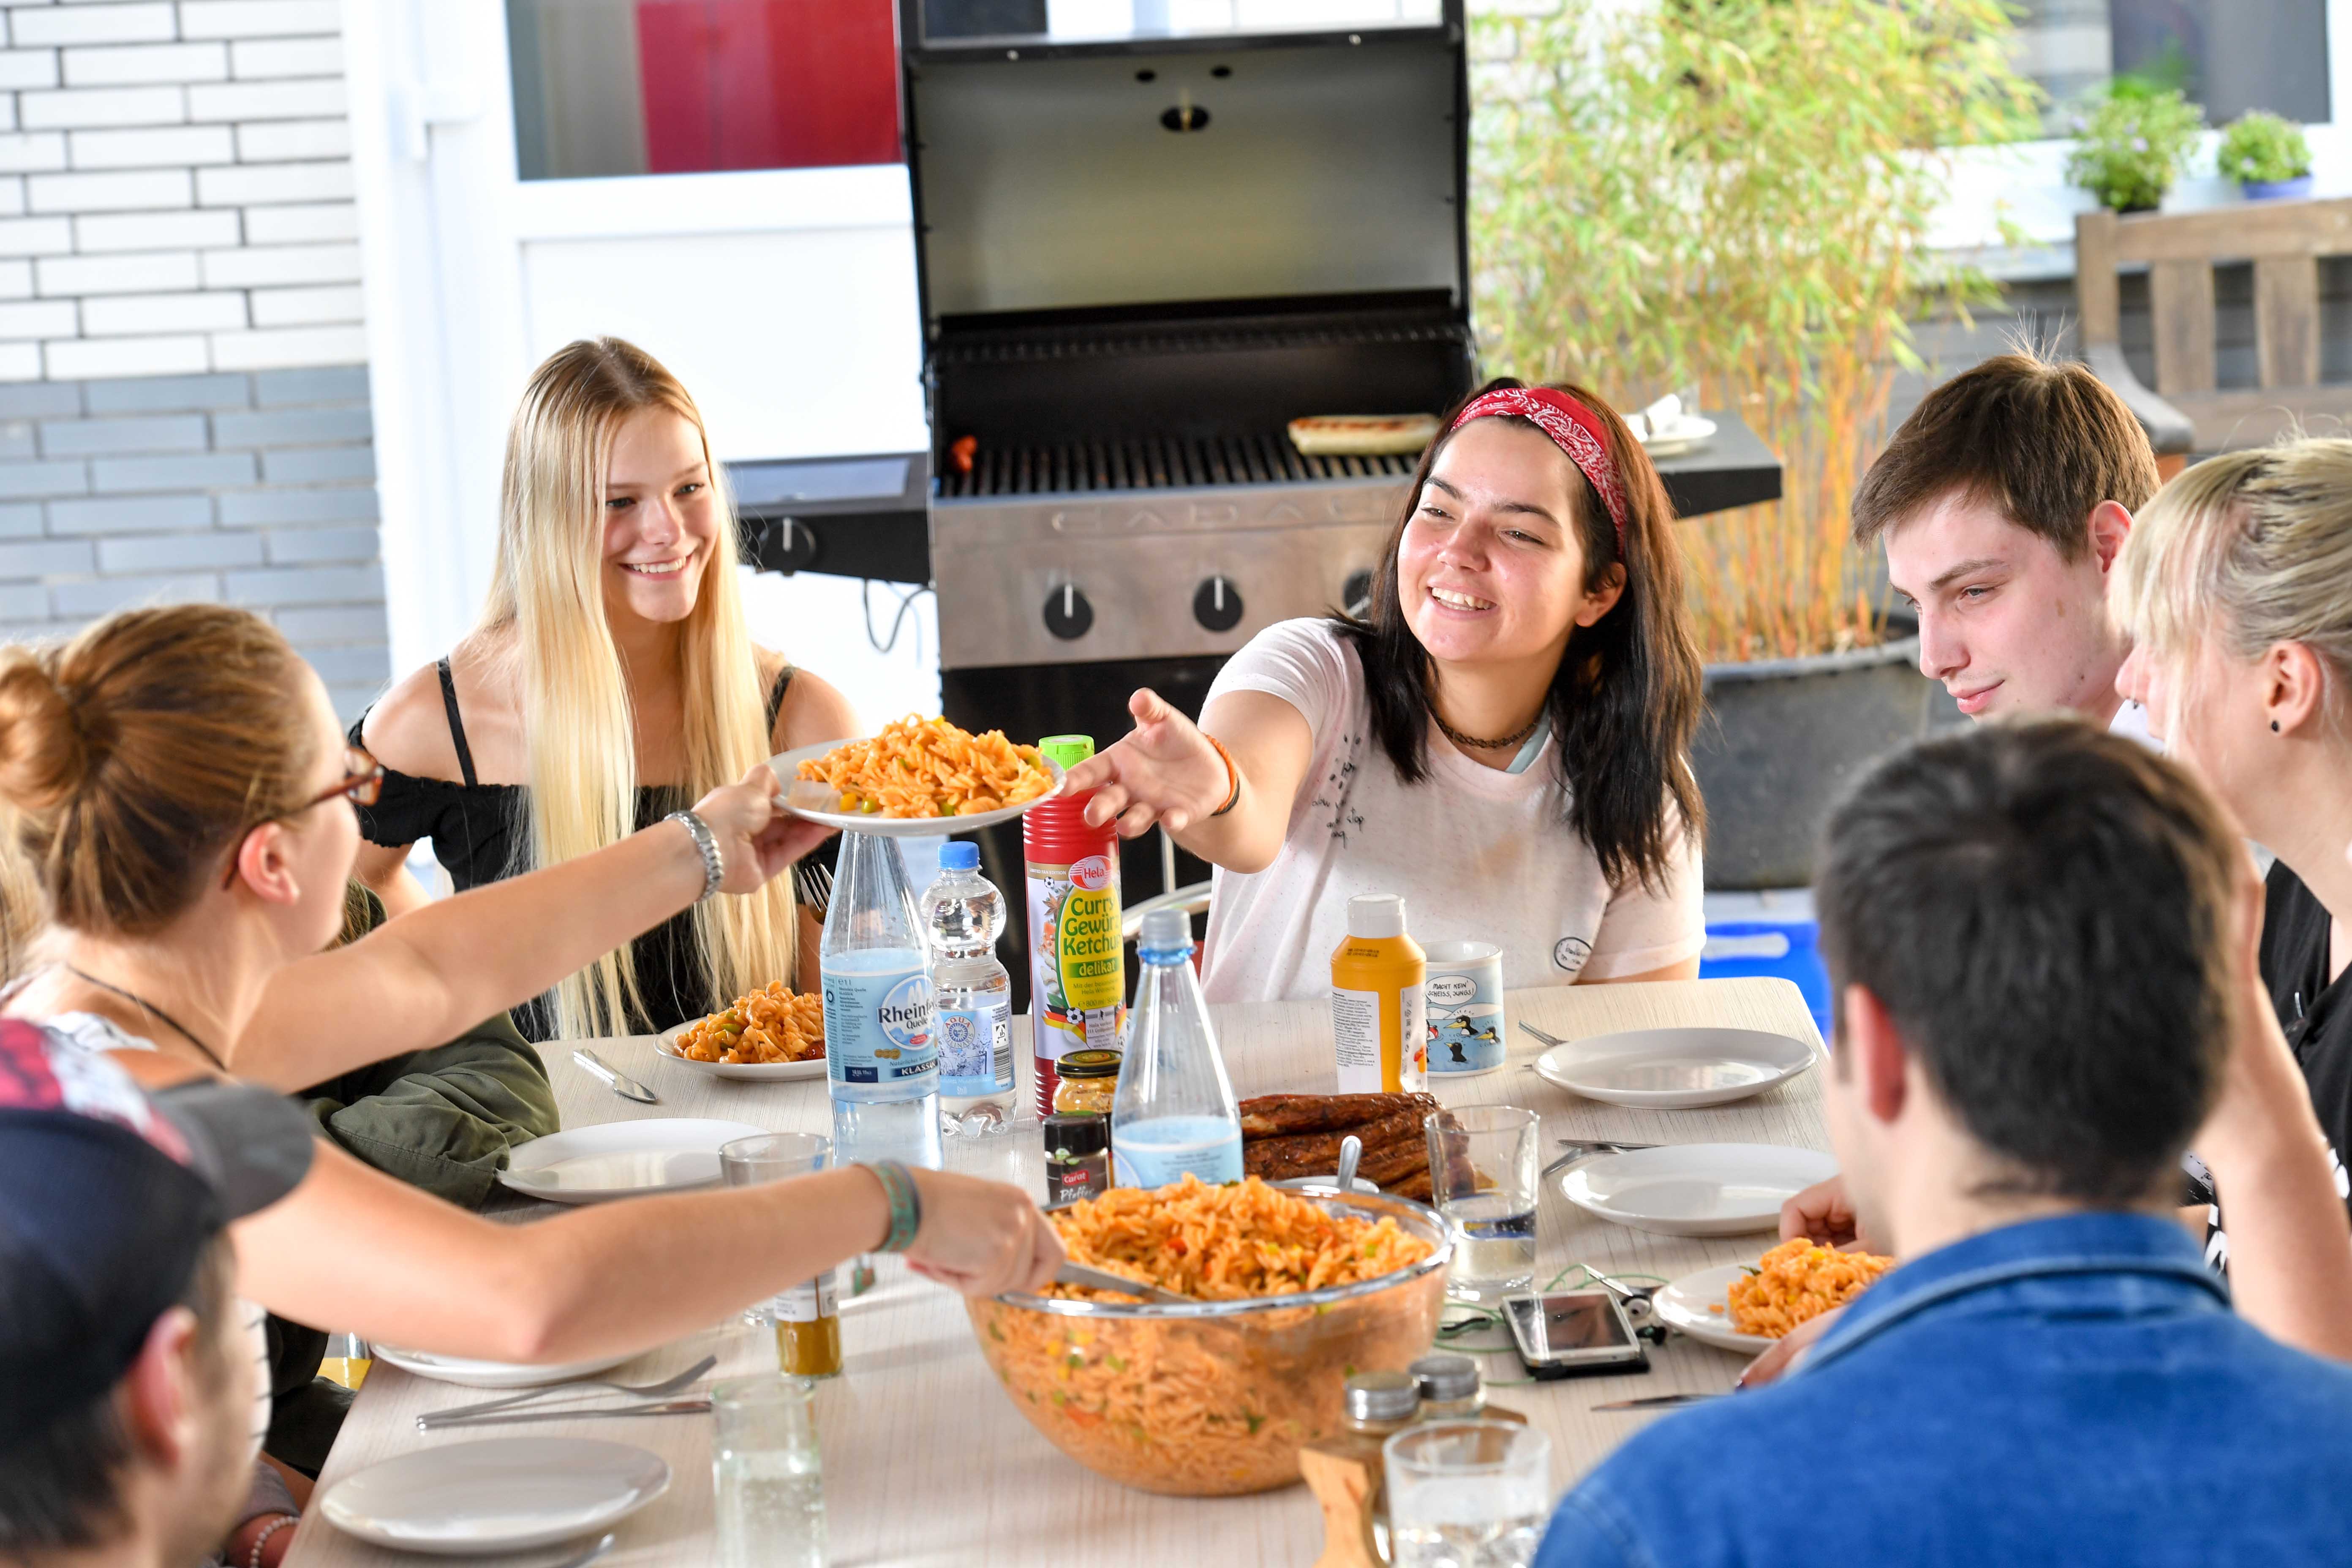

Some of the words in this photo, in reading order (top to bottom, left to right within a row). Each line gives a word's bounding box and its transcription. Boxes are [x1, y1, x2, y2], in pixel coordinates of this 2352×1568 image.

[1083, 866, 1105, 879] Hela
[1071, 897, 1114, 916] Curry
[1079, 959, 1116, 977] delikat
[1453, 980, 1468, 989] KEIN'
[1427, 990, 1451, 999] SCHEISS,
[1453, 987, 1474, 996] JUNGS!
[906, 1016, 928, 1029] Quelle
[945, 1016, 971, 1029] AQUA
[944, 1033, 974, 1048] CULINARIS
[901, 1061, 936, 1075] KLASSIK
[957, 1086, 967, 1095] Still
